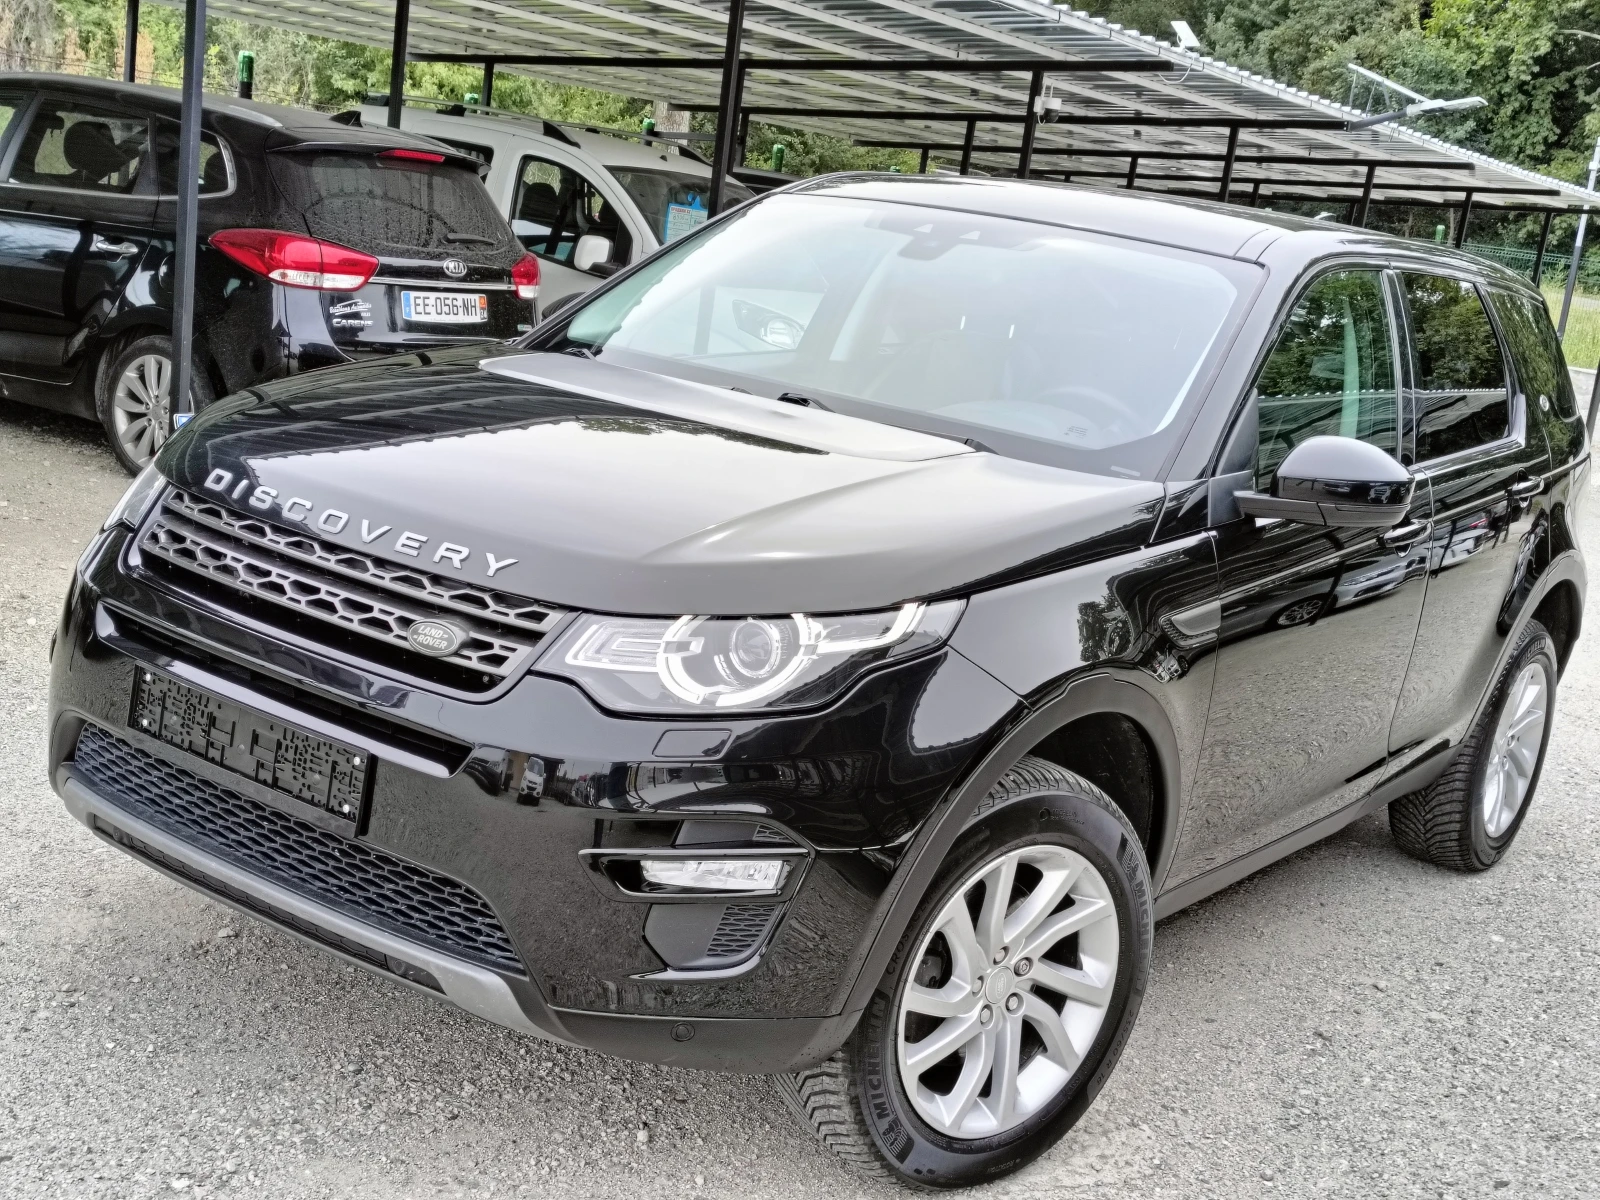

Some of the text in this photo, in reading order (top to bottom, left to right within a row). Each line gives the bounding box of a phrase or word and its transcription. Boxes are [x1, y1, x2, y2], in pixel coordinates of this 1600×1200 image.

[448, 261, 465, 273] KIA
[413, 295, 478, 317] EE-056-NH
[203, 467, 520, 578] DISCOVERY
[417, 625, 444, 639] LAND
[416, 634, 448, 650] ROVER
[866, 996, 891, 1121] MICHELIN
